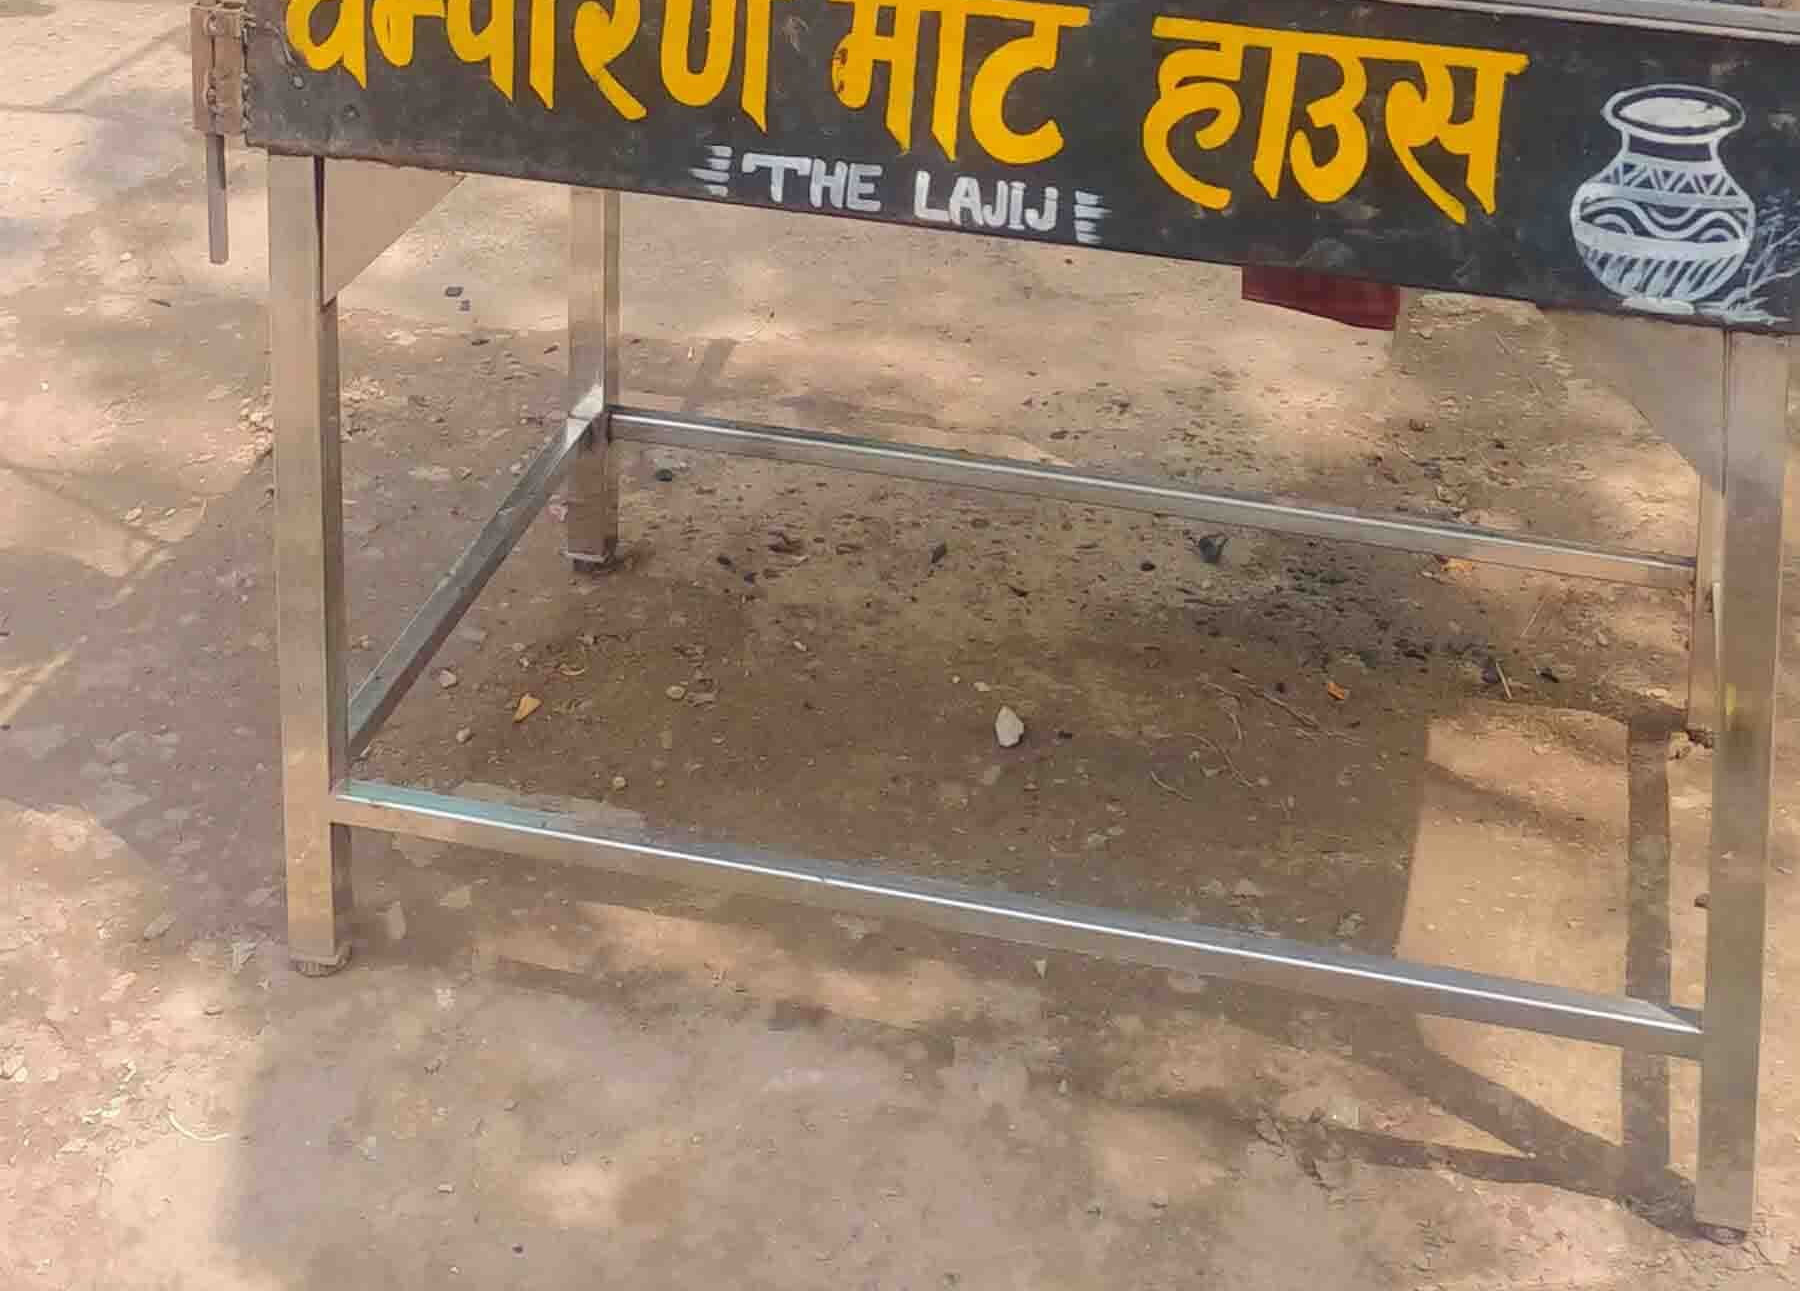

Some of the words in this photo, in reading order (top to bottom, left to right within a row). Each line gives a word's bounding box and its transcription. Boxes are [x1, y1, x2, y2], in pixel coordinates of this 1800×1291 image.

[741, 151, 883, 212] THE
[913, 170, 1059, 232] LAJIJ
[1142, 16, 1530, 224] हाउस
